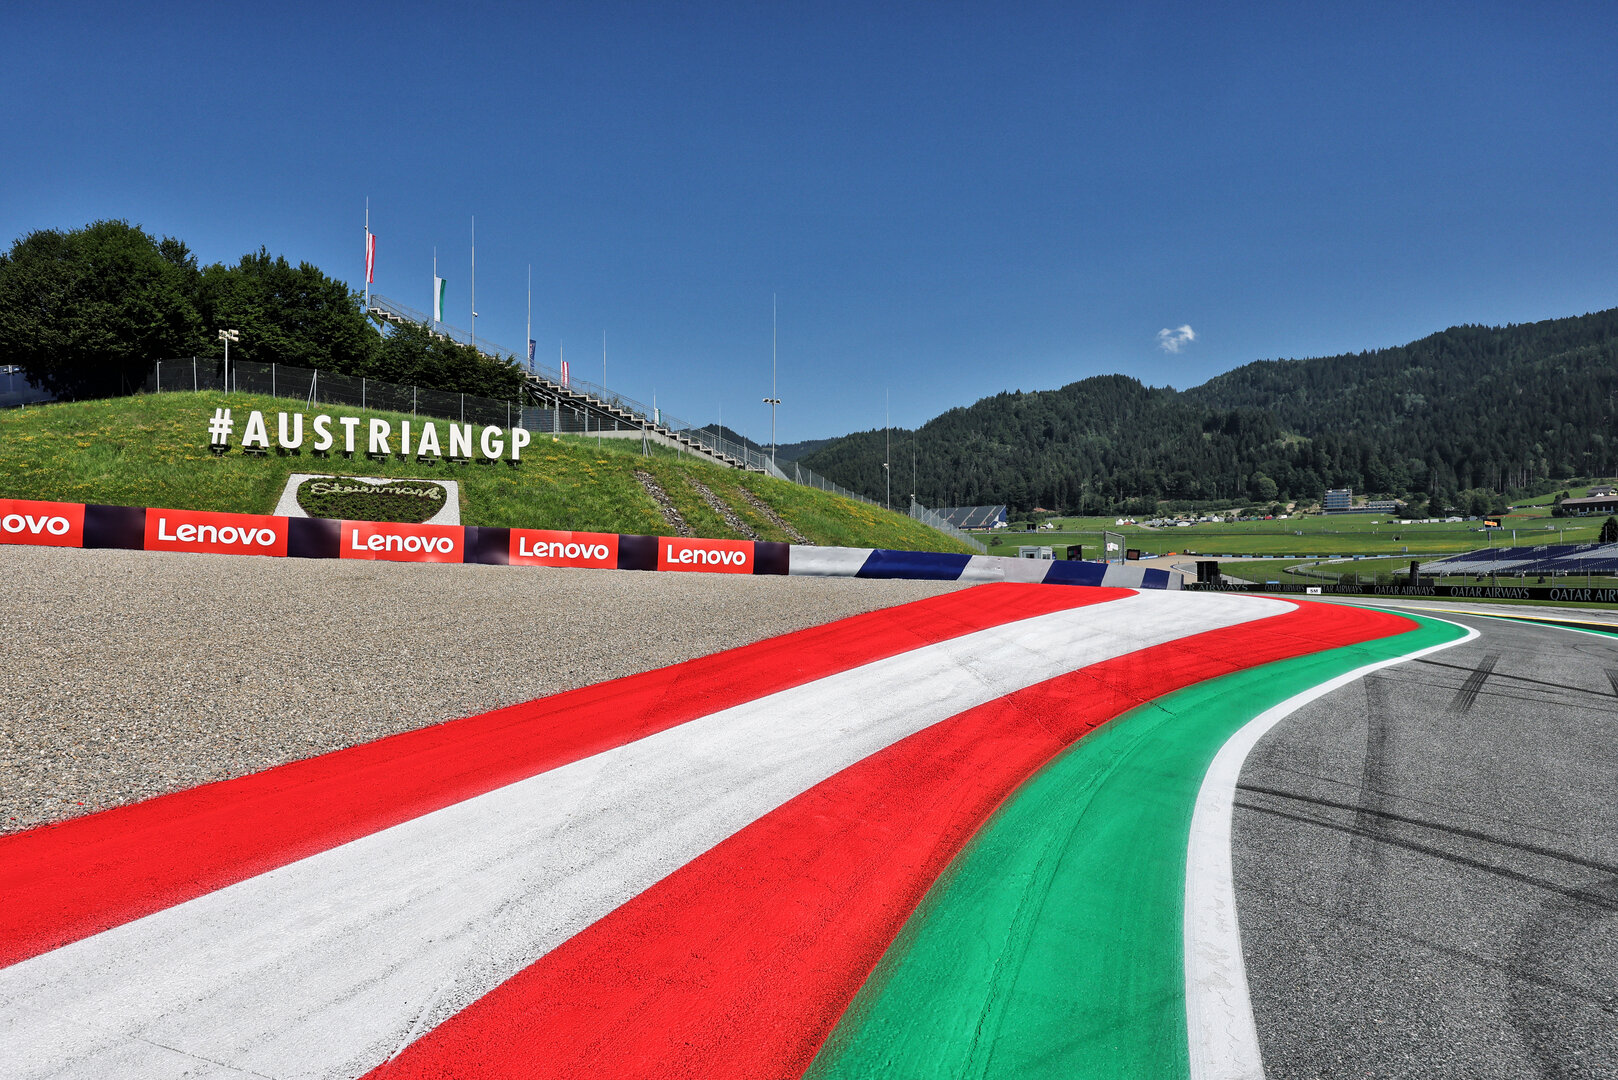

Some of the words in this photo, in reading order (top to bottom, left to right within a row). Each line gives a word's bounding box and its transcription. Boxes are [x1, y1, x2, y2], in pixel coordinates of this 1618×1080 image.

[207, 408, 531, 460] #AUSTRIANGP
[310, 482, 442, 500] Steiermark
[0, 514, 70, 535] ovo
[158, 518, 276, 546] Lenovo
[352, 529, 454, 553] Lenovo
[519, 537, 609, 560] Lenovo
[667, 544, 746, 566] Lenovo
[1264, 584, 1281, 592] QATAR
[1335, 584, 1362, 593] AIRWAYS
[1374, 585, 1399, 595] QATAR
[1400, 585, 1436, 596] AIRWAYS
[1450, 586, 1482, 598] QATAR
[1485, 587, 1529, 599] AIRWAYS
[1550, 588, 1592, 601] QATAR
[1595, 589, 1618, 602] AIR
